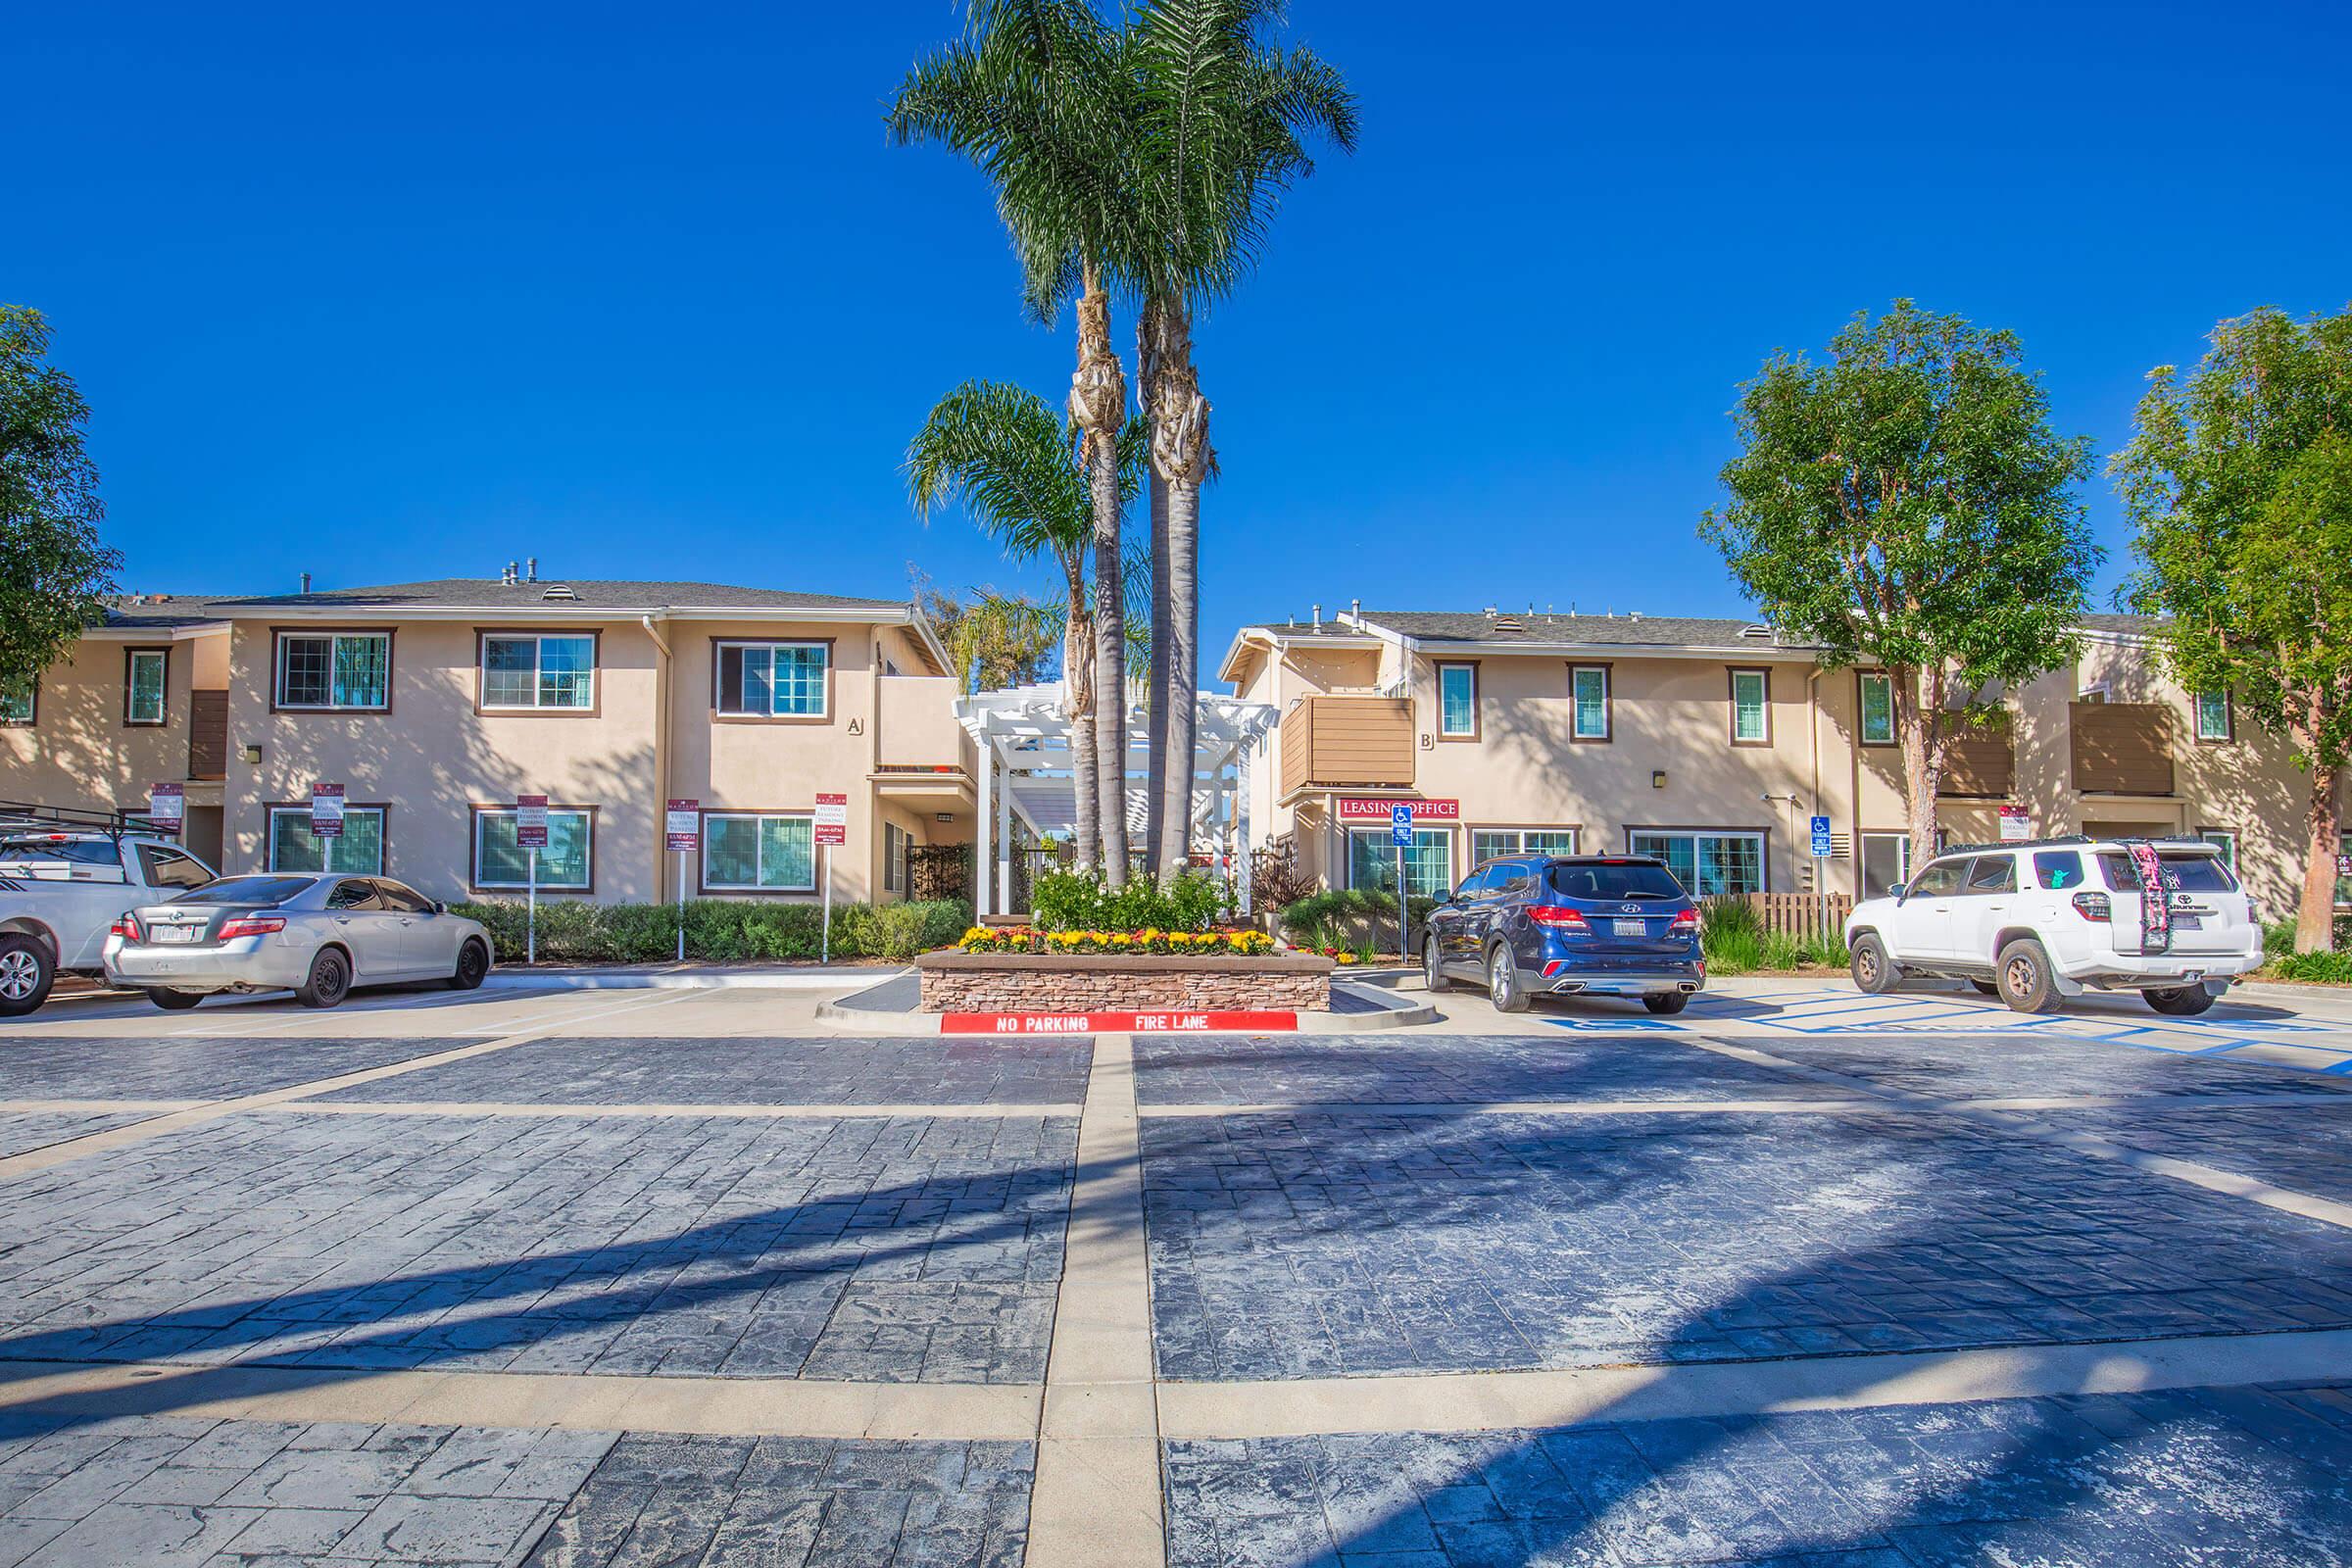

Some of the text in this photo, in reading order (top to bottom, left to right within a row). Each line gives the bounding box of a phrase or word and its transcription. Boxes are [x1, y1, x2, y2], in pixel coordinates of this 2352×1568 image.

[848, 717, 859, 732] A
[1421, 734, 1430, 747] B
[1344, 802, 1456, 814] LEASIN OFFICE
[997, 1015, 1208, 1032] NO PARKING FIRE LANE
